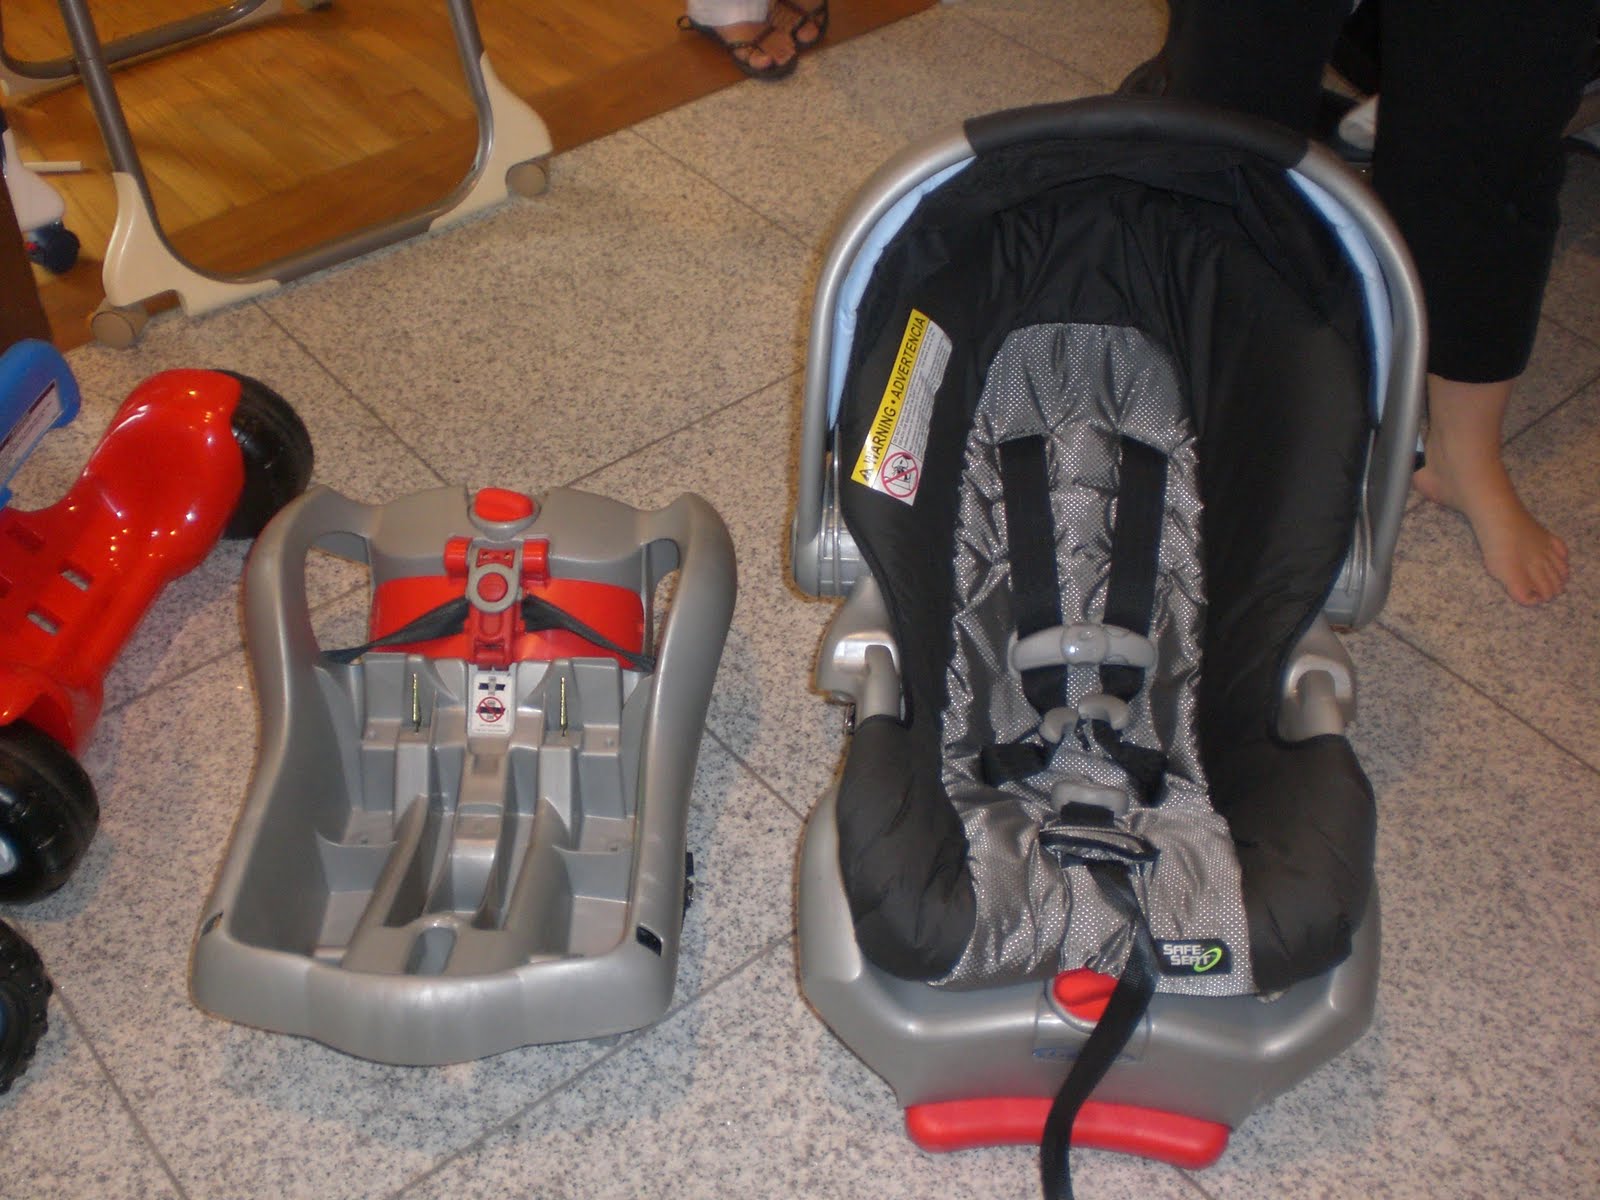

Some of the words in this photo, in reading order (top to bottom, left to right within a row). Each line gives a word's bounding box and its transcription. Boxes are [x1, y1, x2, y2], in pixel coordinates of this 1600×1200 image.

[864, 406, 896, 465] WARNING
[892, 317, 926, 400] ADVERTENCIA
[1170, 955, 1211, 966] SEAT
